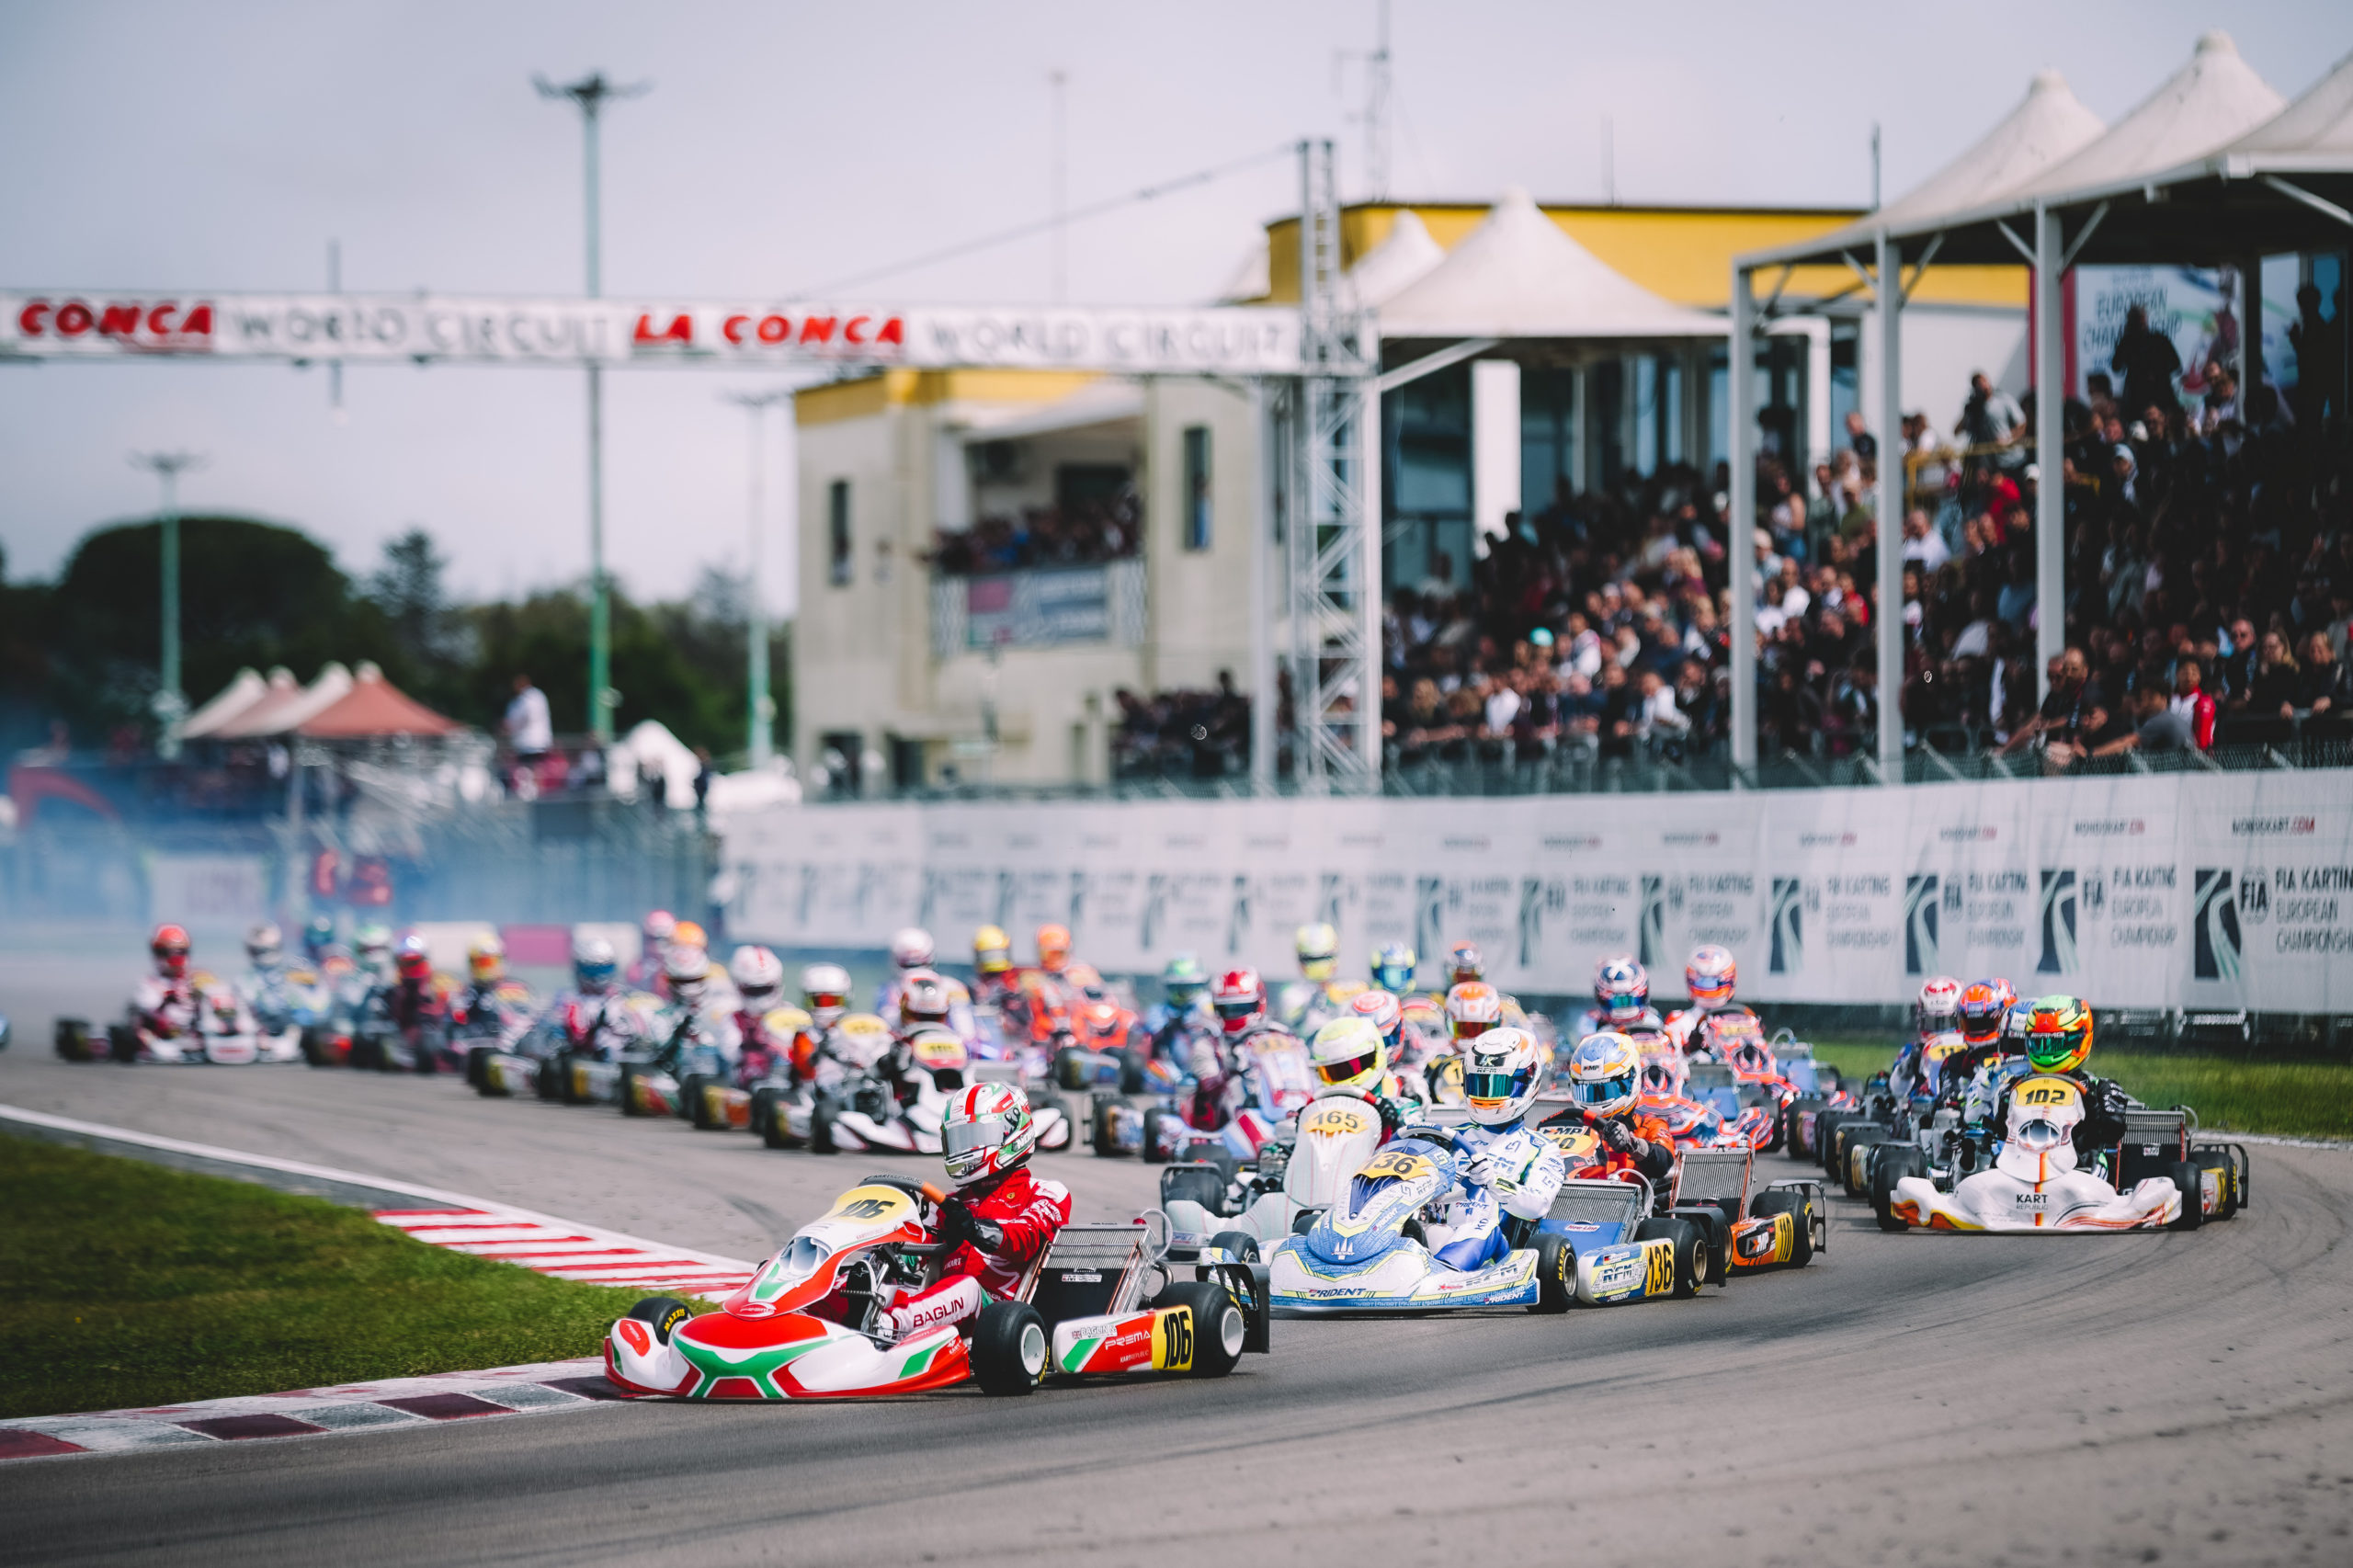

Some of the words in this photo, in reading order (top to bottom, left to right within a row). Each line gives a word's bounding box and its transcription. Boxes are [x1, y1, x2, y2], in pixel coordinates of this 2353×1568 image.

[18, 302, 212, 338] CONCA
[241, 307, 407, 346] WORLD
[631, 313, 692, 346] LA
[722, 313, 904, 347] CONCA
[2276, 866, 2296, 892] FIA
[2276, 898, 2338, 923] EUROPEAN
[2025, 1089, 2065, 1105] 102
[1313, 1110, 1359, 1130] 165
[1364, 1153, 1419, 1175] 136
[2017, 1194, 2048, 1204] KART
[1647, 1244, 1673, 1293] 136
[664, 1308, 686, 1333] MAXXIS
[913, 1296, 964, 1328] BAGLIN
[1105, 1330, 1151, 1350] PREMA
[1163, 1311, 1192, 1369] 106
